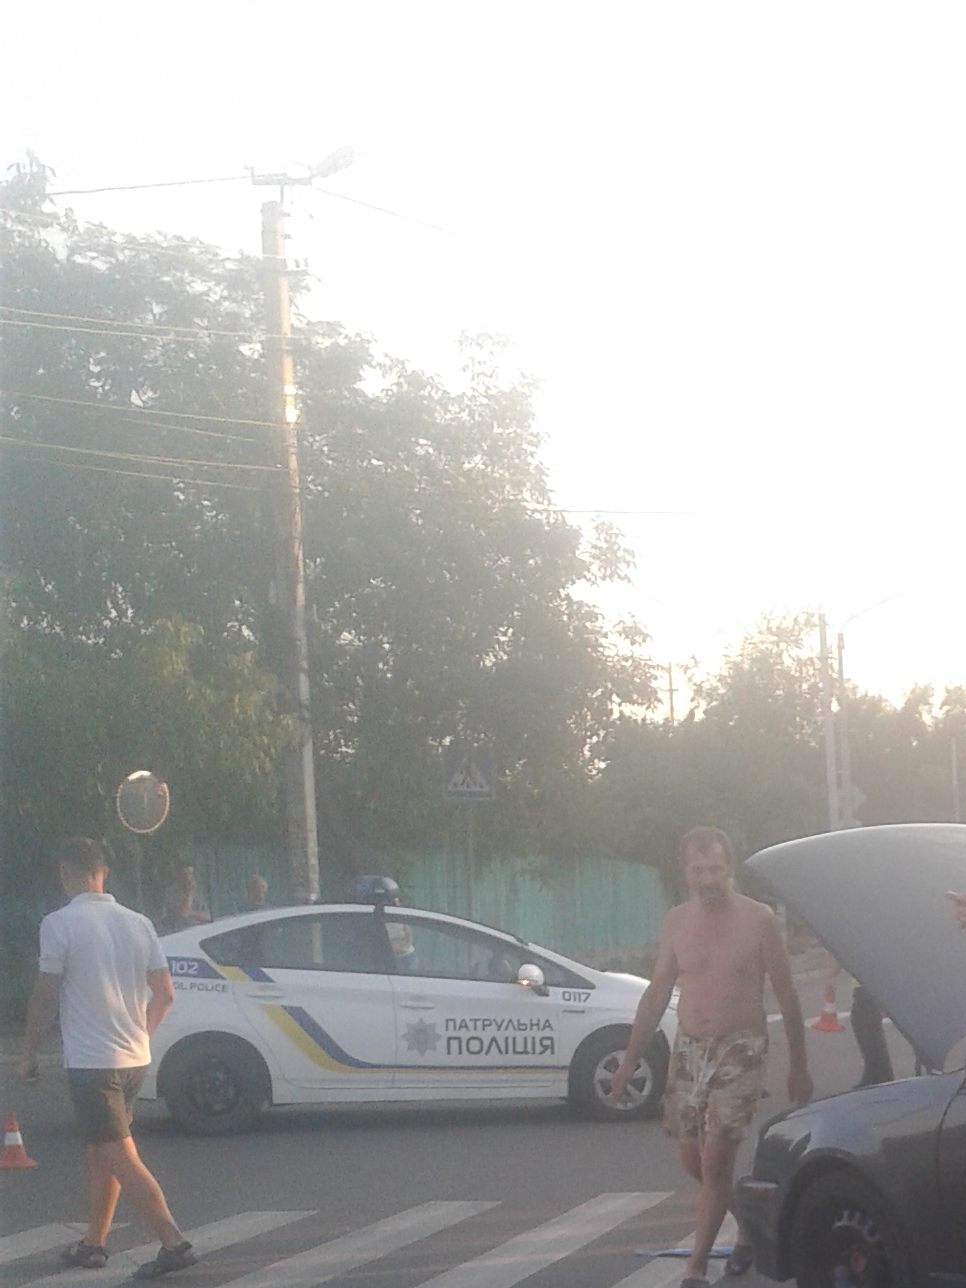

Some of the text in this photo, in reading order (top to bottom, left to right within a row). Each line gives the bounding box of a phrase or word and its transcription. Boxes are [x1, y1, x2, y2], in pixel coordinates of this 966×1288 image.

[171, 960, 199, 975] 102
[189, 981, 229, 993] POLICE
[561, 990, 592, 1004] 0117
[444, 1018, 554, 1032] ПАТРУЛЬНА
[446, 1035, 556, 1056] ПОЛІЦІЯ
